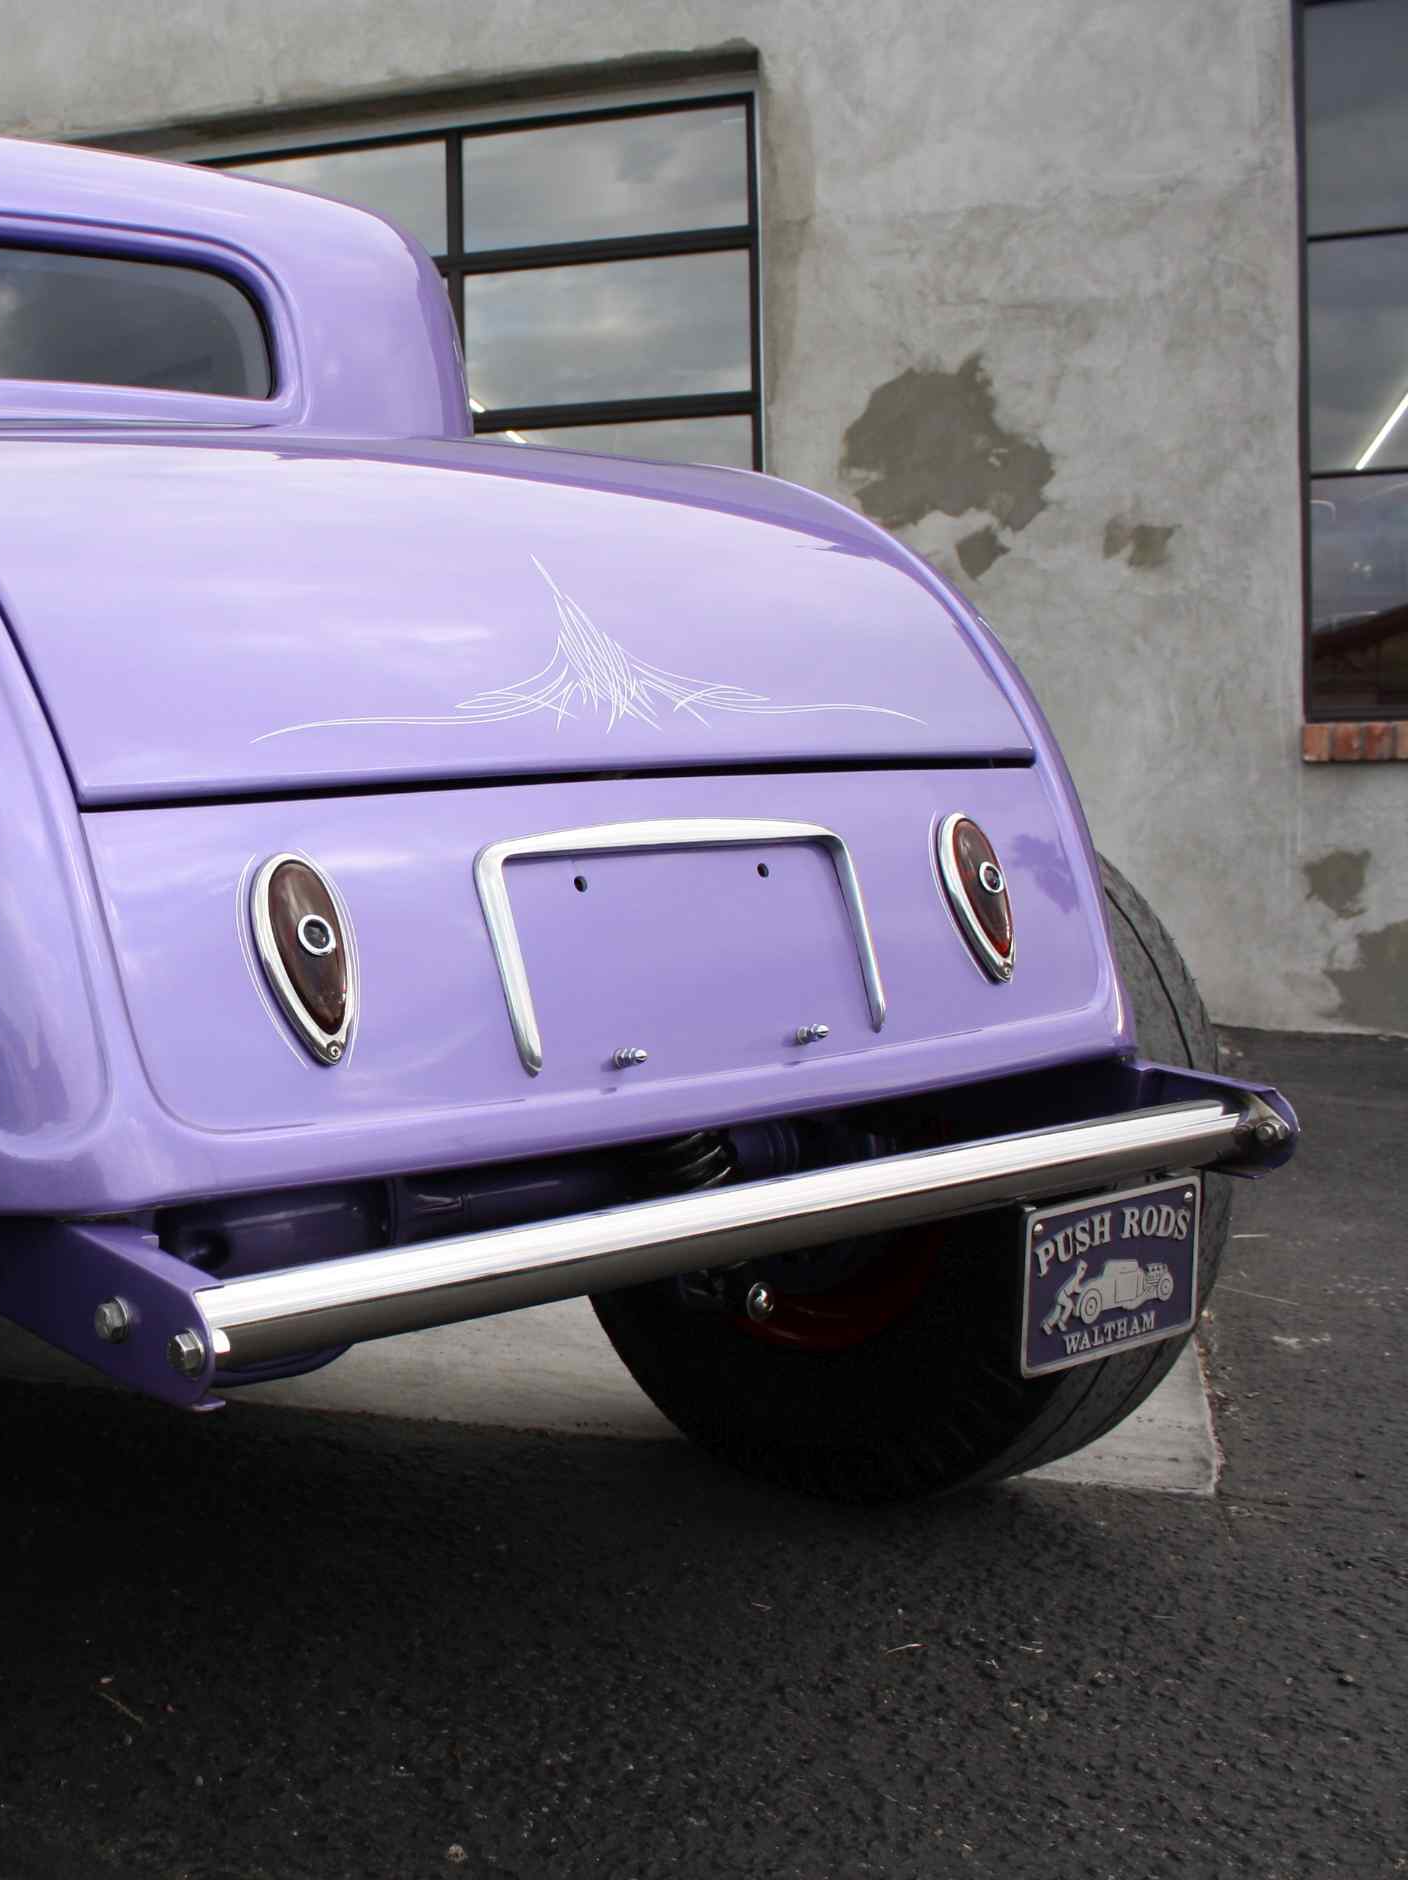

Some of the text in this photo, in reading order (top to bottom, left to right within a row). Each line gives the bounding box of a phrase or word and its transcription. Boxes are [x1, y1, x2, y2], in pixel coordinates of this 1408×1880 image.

[1035, 1204, 1191, 1276] PUSH RODS
[1063, 1311, 1155, 1354] WALTHAM
